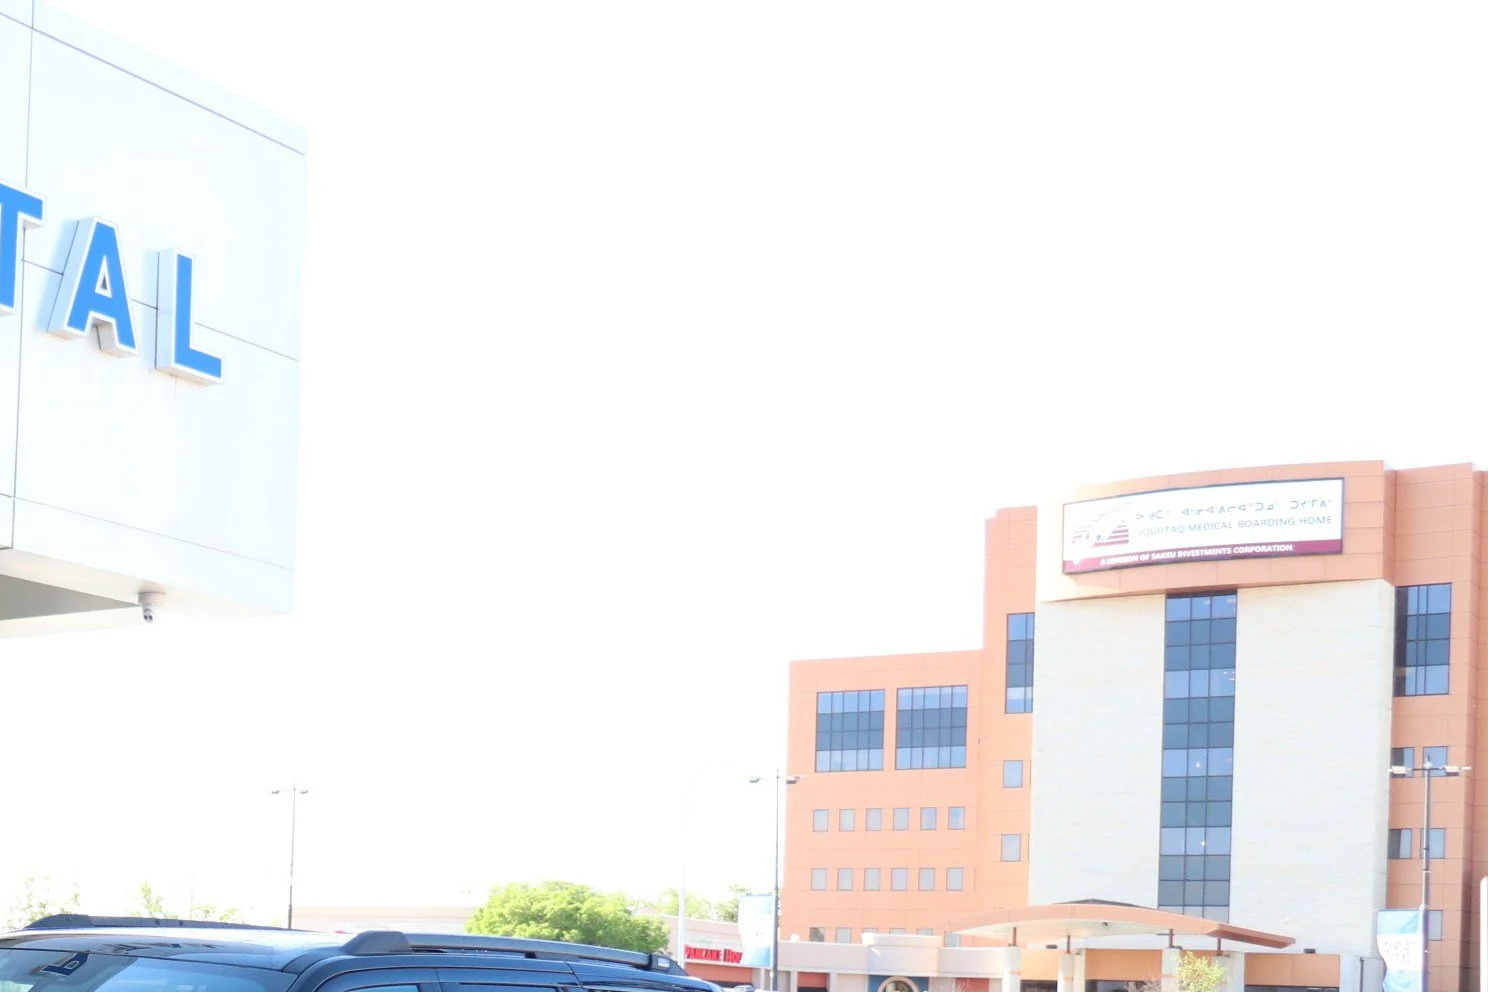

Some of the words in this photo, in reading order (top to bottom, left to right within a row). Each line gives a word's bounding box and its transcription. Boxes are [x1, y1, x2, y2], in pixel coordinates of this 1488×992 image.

[1188, 520, 1233, 532] MEDICAL
[1238, 517, 1295, 529] BOARDING
[1299, 515, 1333, 526] HOME
[1140, 553, 1151, 562] OF
[1177, 547, 1232, 558] INVESTMENTS
[1233, 543, 1293, 555] CORPORATION
